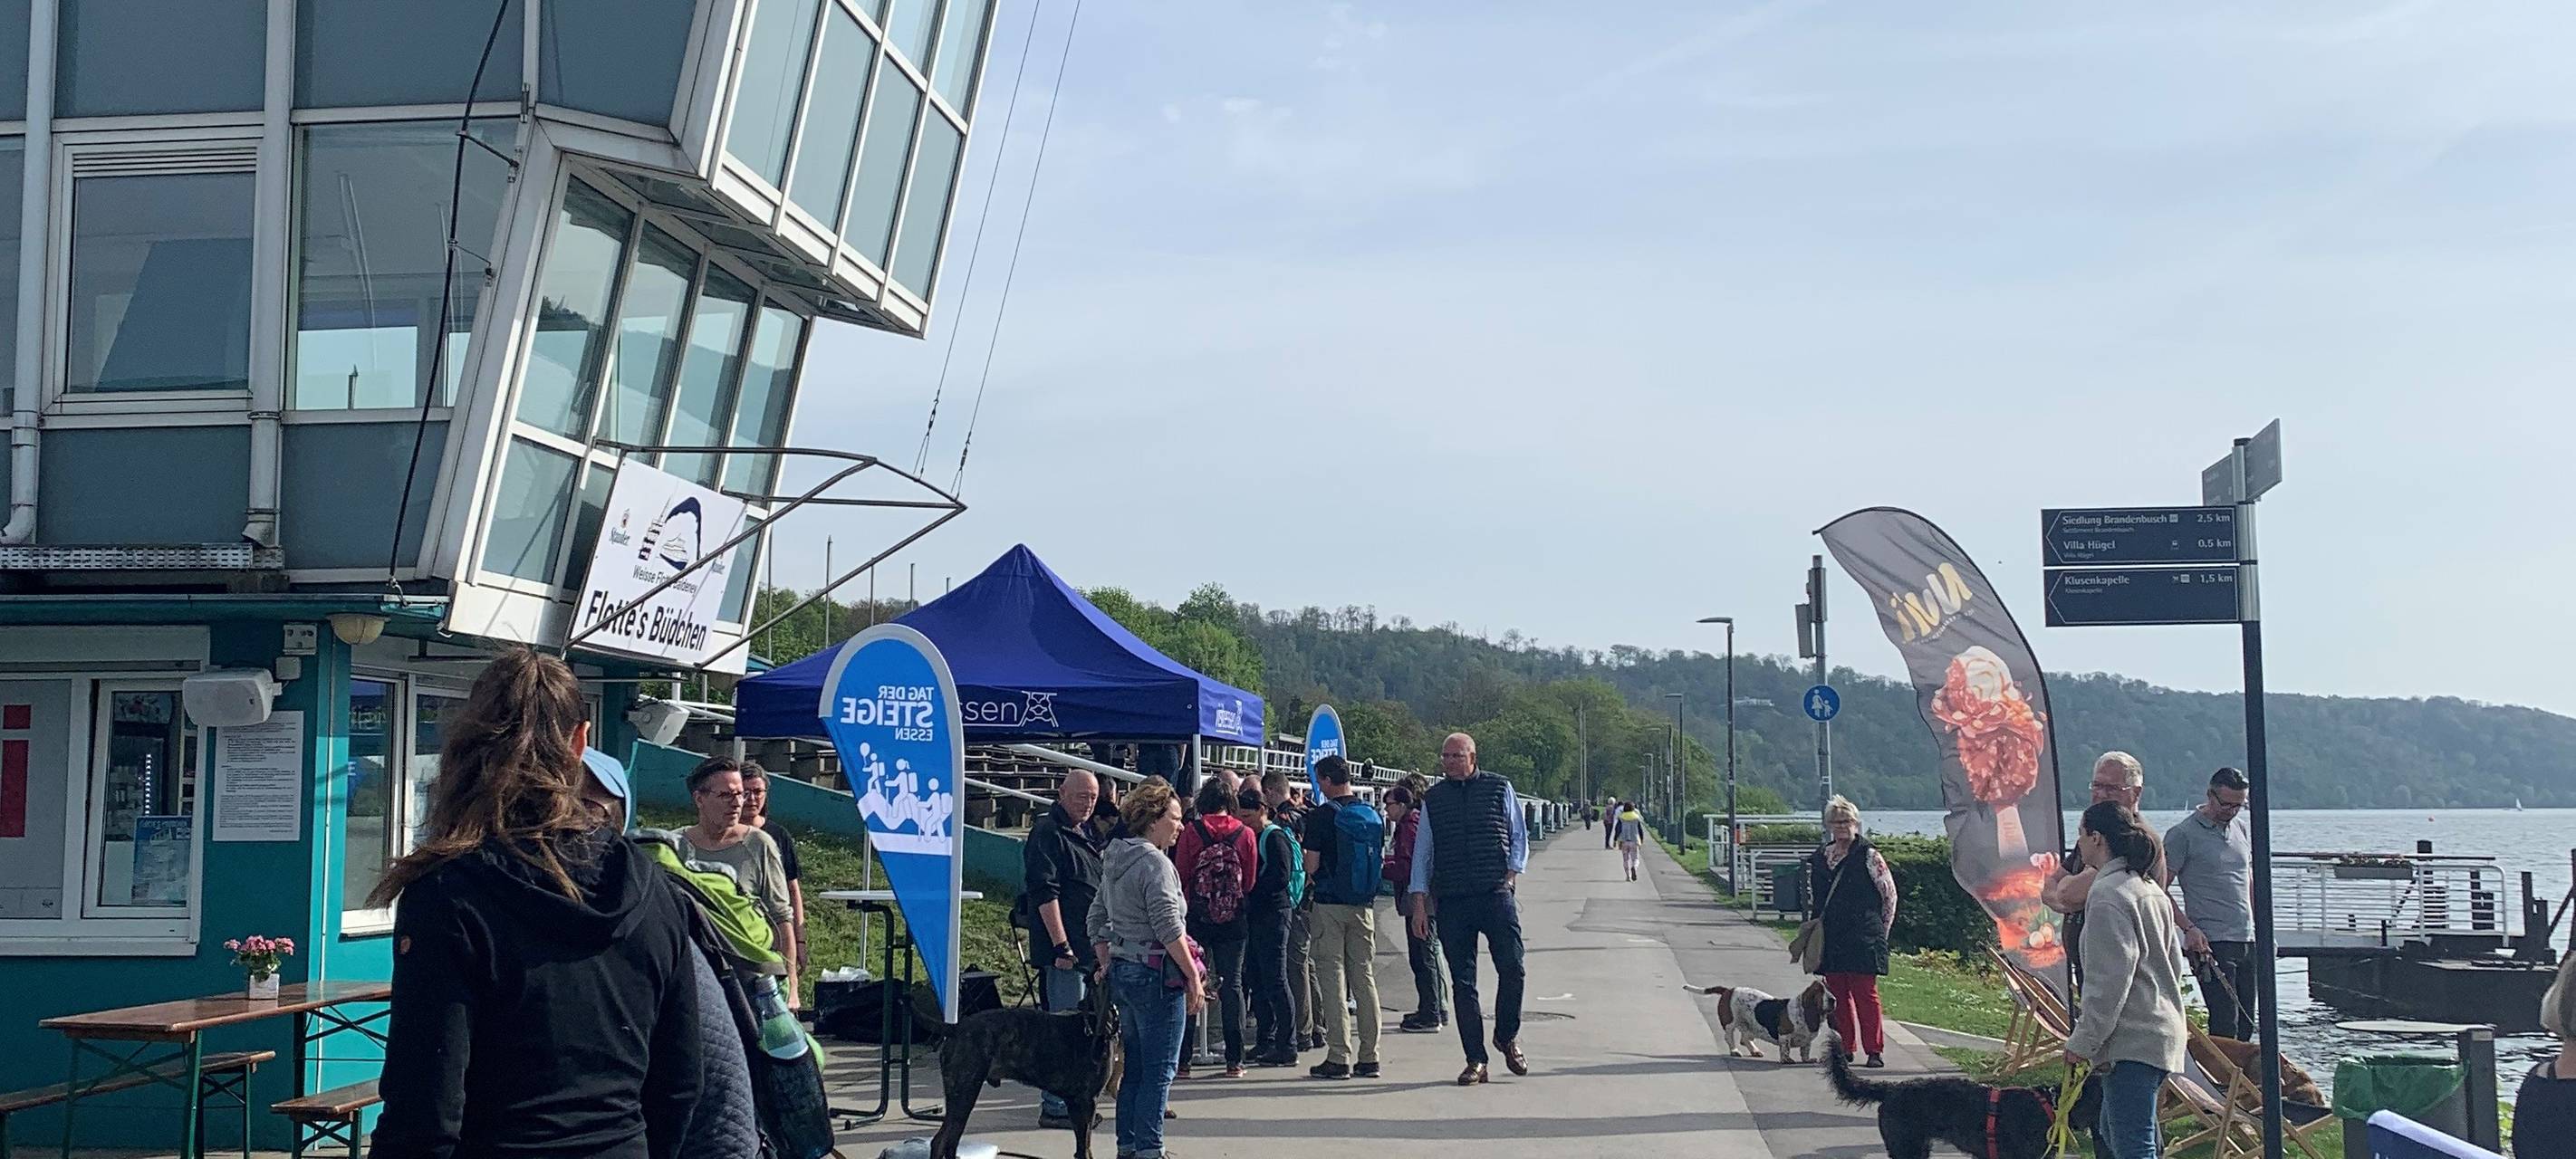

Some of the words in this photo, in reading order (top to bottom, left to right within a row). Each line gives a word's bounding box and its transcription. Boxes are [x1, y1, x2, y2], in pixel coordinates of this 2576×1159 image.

[2062, 515, 2101, 526] Siedlung
[2104, 513, 2167, 524] Brandenbusch
[2196, 513, 2213, 523] 2,5
[2216, 512, 2231, 522] km
[2063, 541, 2084, 550] Villa
[2087, 540, 2116, 551] Hügel
[2197, 539, 2214, 549] 0,5
[2216, 538, 2232, 548] km
[632, 565, 656, 584] Weisse
[2064, 575, 2129, 587] Klusenkapelle
[2200, 574, 2216, 584] 1,5
[2217, 573, 2233, 583] km
[584, 589, 649, 639] Flotte's
[649, 606, 706, 651] Büdchen
